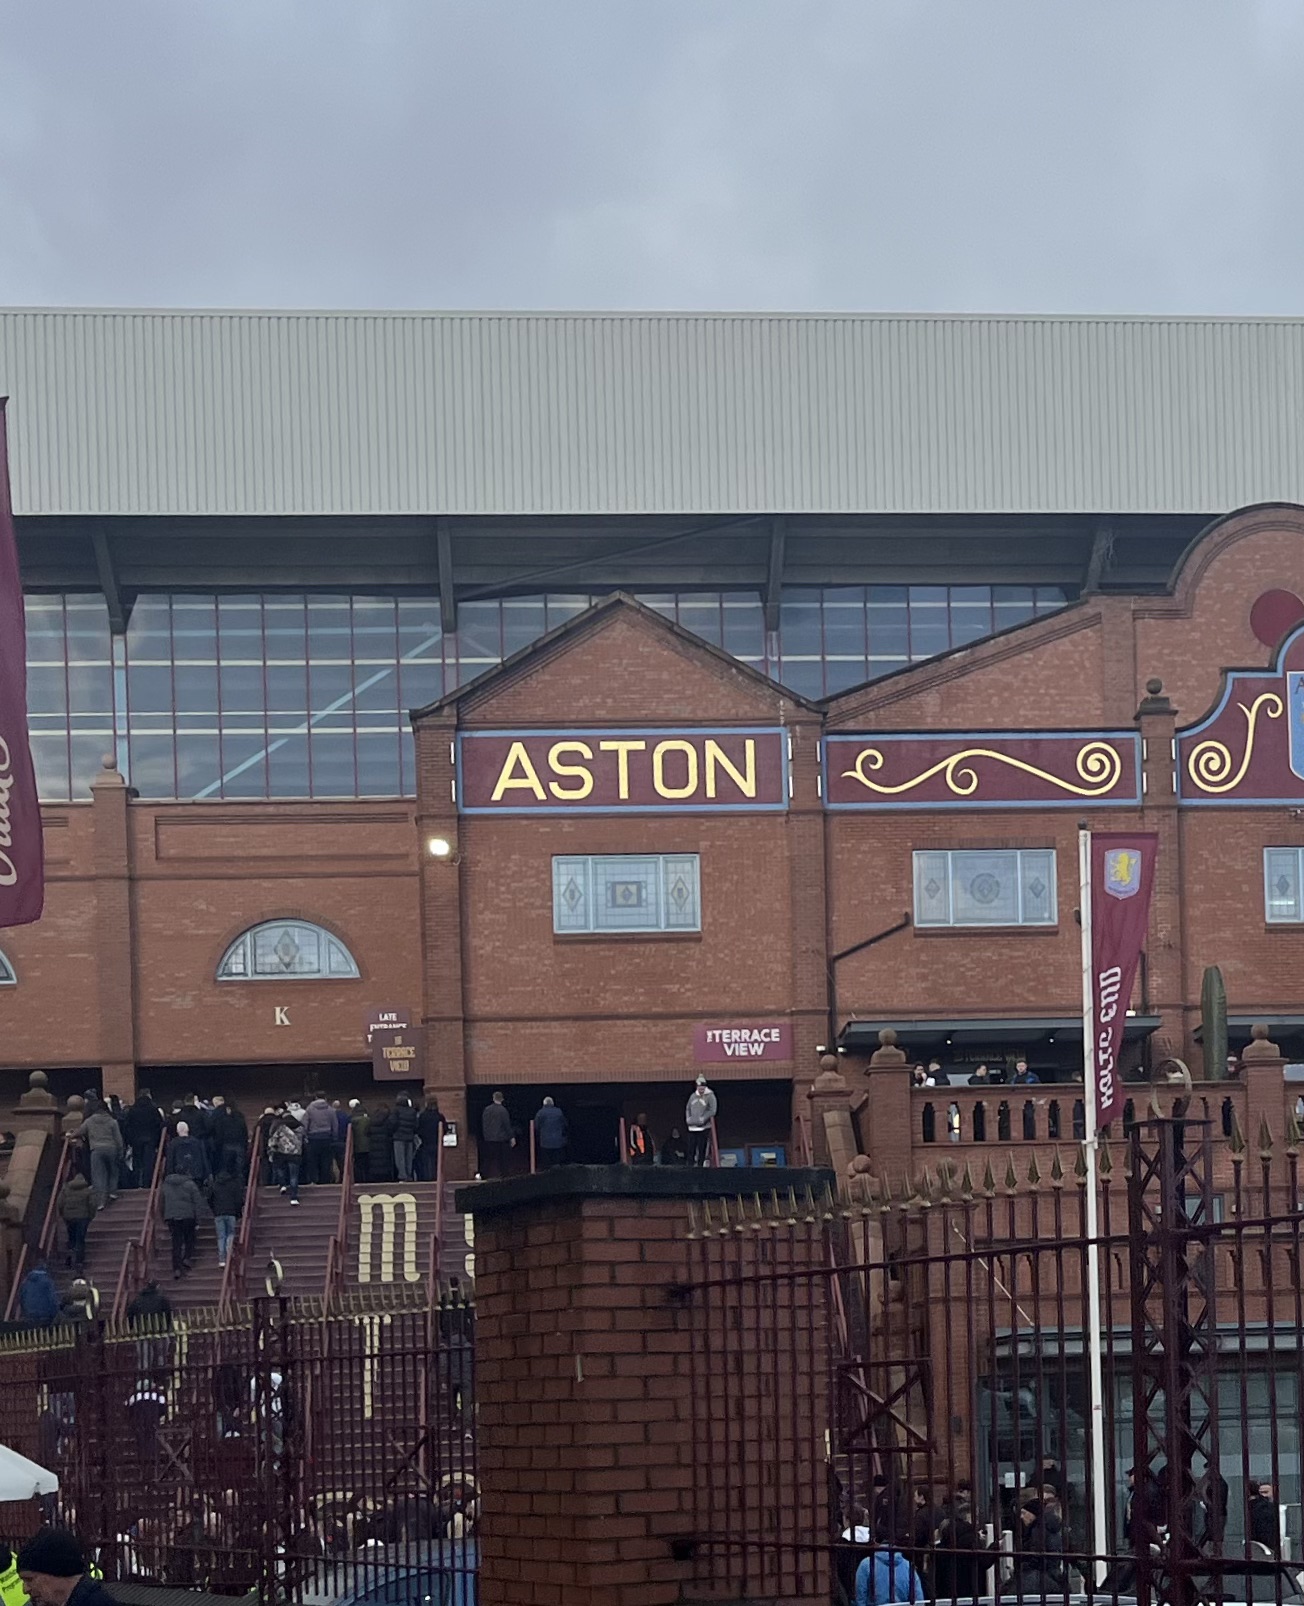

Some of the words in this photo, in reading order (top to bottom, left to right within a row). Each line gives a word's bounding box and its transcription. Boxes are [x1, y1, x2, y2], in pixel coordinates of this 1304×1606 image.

[490, 739, 756, 801] ASTON
[274, 1006, 291, 1026] K
[379, 1012, 398, 1022] LATE
[713, 1028, 780, 1042] TERRACE
[723, 1043, 764, 1056] VIEW
